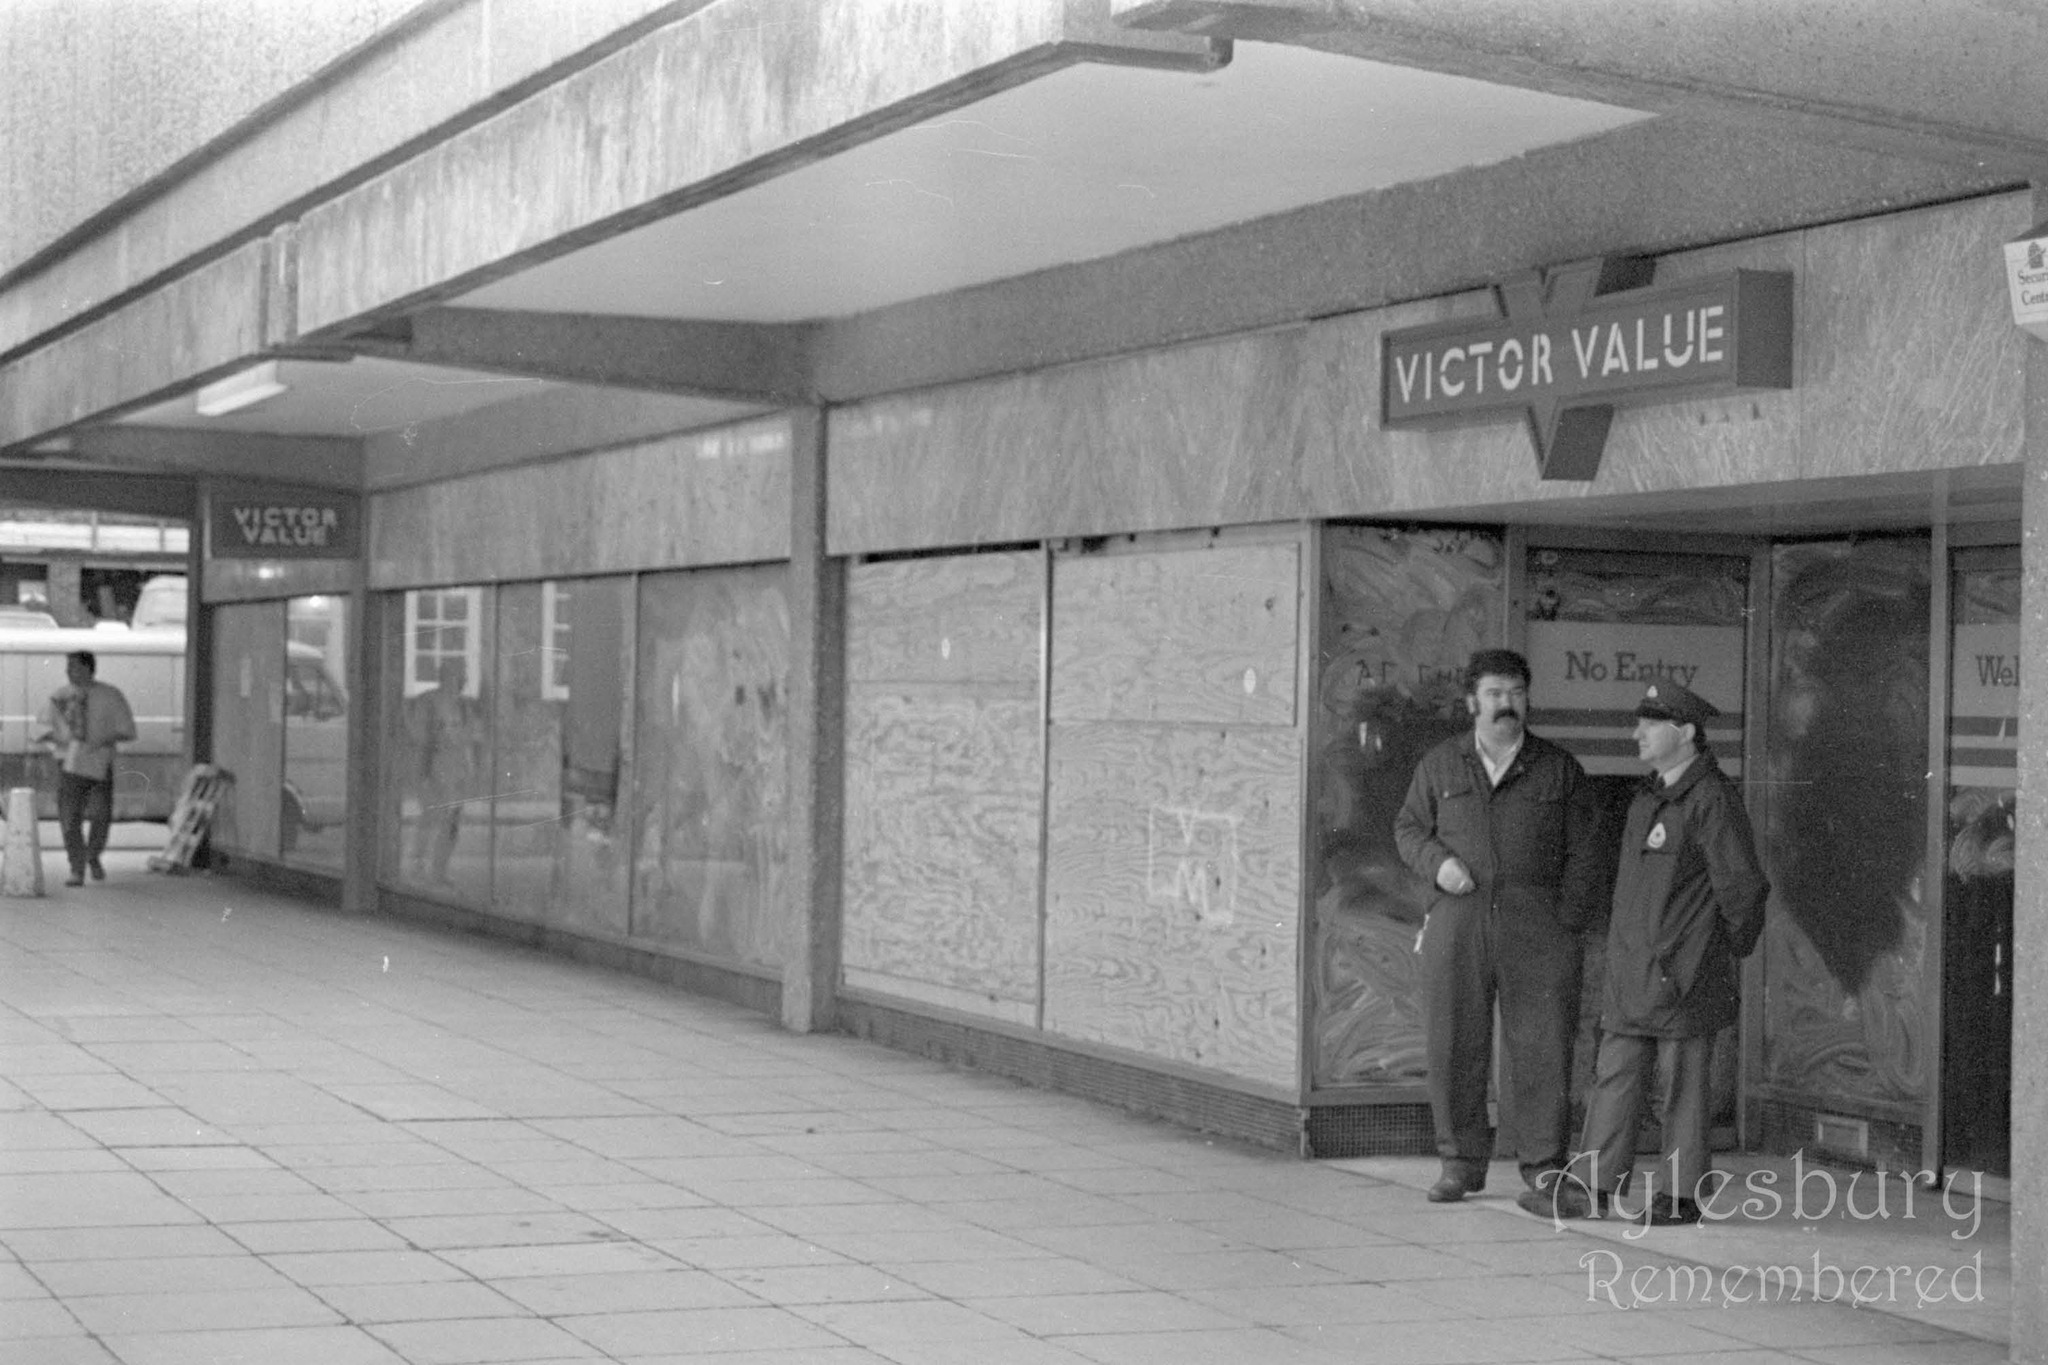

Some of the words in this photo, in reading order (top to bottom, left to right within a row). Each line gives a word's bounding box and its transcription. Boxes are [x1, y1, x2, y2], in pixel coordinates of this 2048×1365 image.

[1396, 333, 1553, 402] VICTOR
[1572, 306, 1724, 379] VALUE
[234, 507, 337, 527] VICTOR
[243, 526, 326, 545] VALUE
[1565, 650, 1608, 681] No
[1614, 651, 1698, 688] Entry
[1976, 654, 2020, 687] Wel
